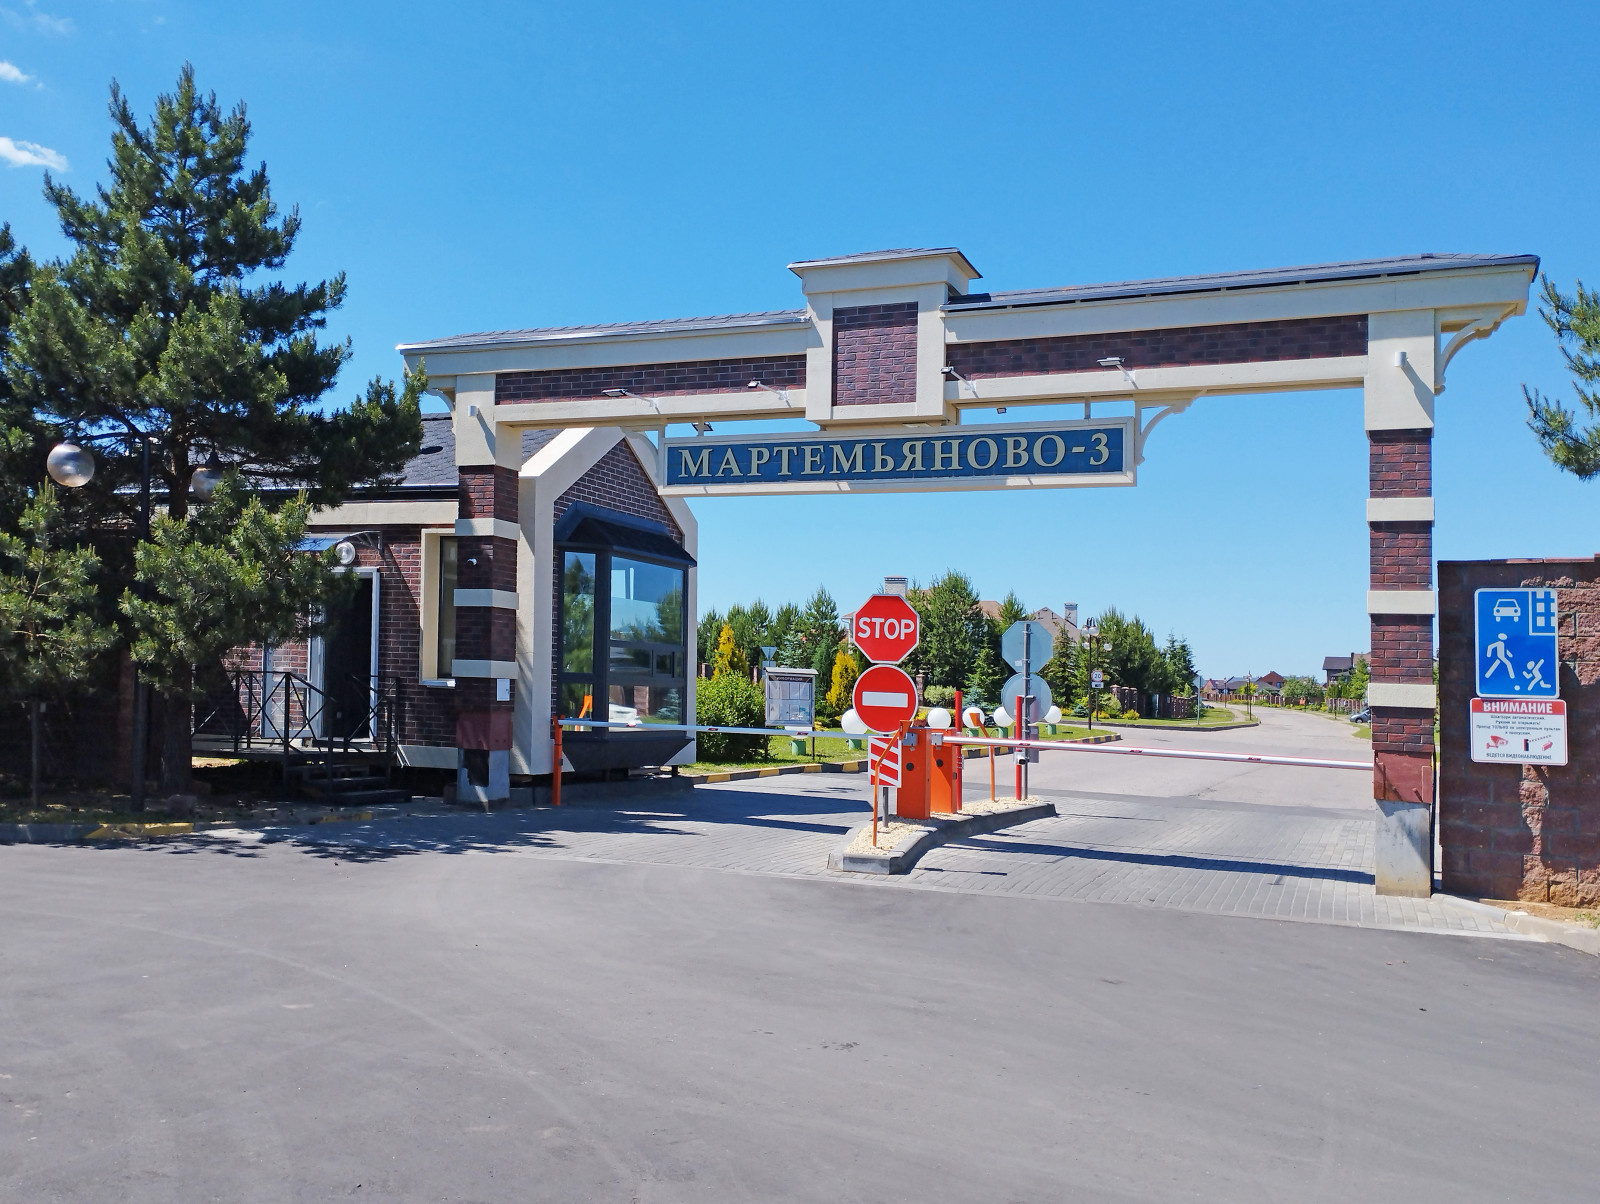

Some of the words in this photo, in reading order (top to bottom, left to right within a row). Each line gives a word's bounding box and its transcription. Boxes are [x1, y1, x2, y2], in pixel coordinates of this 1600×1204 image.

[678, 432, 1110, 478] МАРТЕМЬЯНОВО-3
[857, 616, 915, 640] STOP
[1483, 701, 1553, 714] ВНИМАНИЕ
